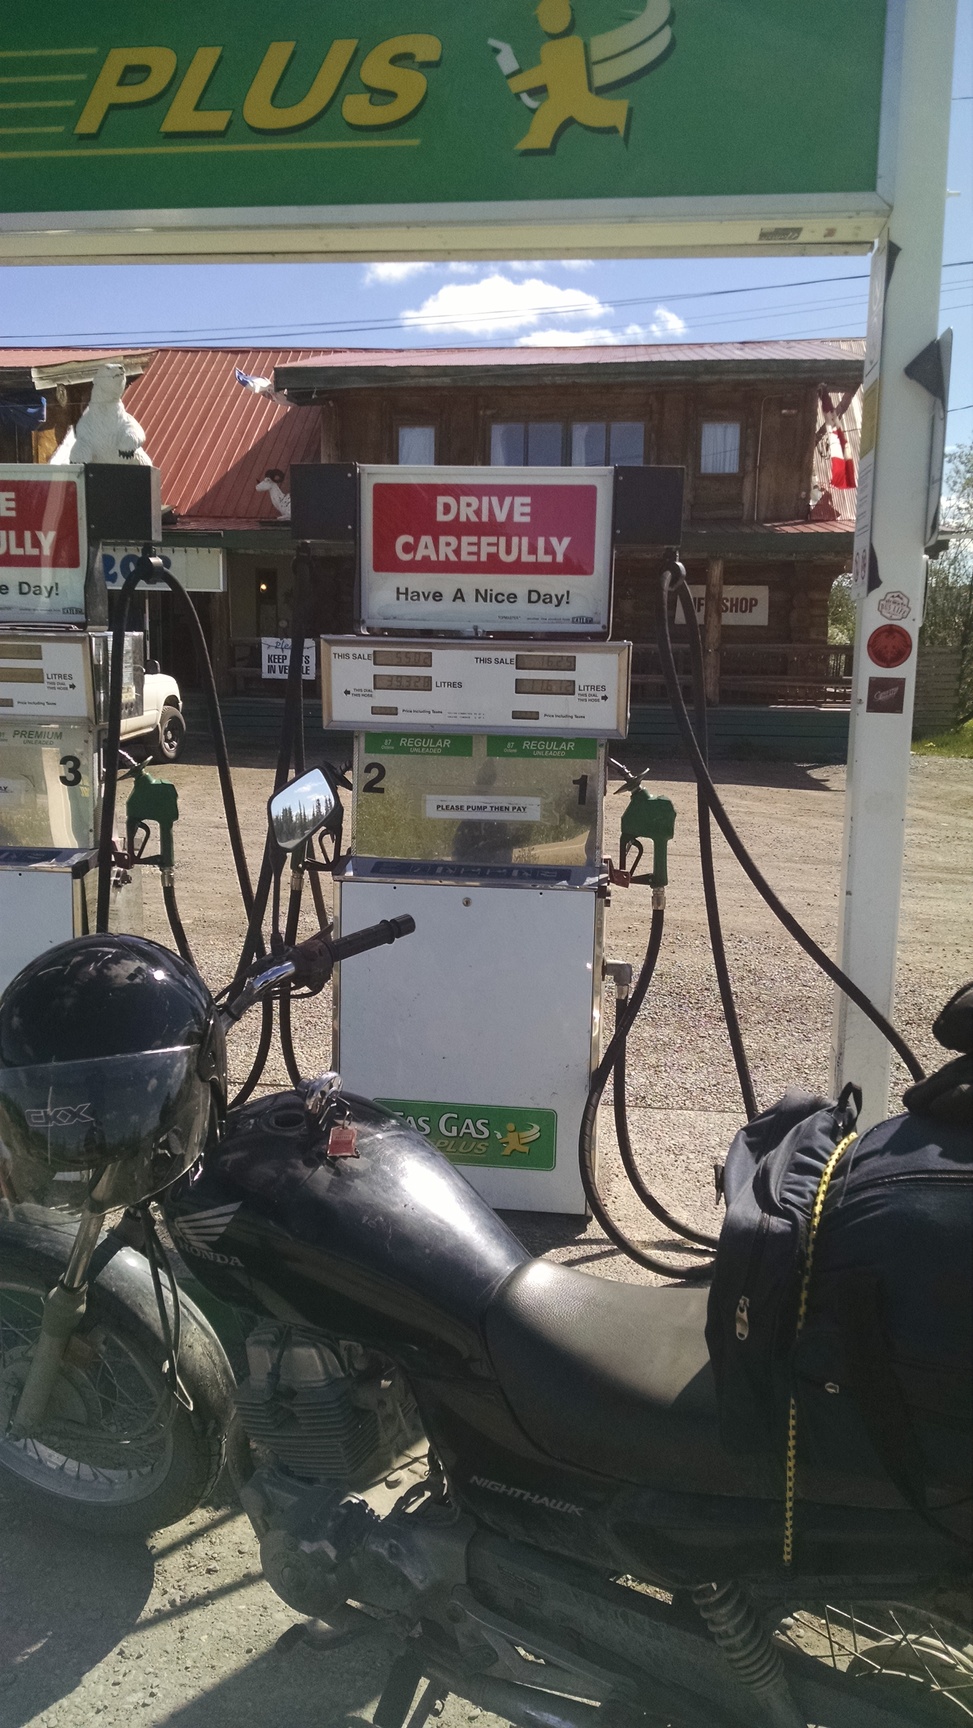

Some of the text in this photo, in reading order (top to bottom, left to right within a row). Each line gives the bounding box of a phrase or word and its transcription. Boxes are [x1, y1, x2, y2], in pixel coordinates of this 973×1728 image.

[74, 33, 443, 138] PLUS
[436, 495, 531, 522] DRIVE
[395, 534, 572, 563] CAREFULLY
[18, 581, 59, 599] Day!
[396, 587, 570, 608] Have A Nice Day!
[721, 597, 759, 613] SHOP
[267, 653, 288, 664] KEEP
[333, 652, 372, 661] THIS SALE
[474, 656, 515, 665] THIS SALE
[46, 673, 73, 681] LITRES
[267, 664, 277, 674] IN
[435, 681, 463, 689] LITRES
[578, 684, 607, 692] LITRES
[12, 730, 63, 740] PREMIUM
[399, 737, 451, 748] REGULAR
[522, 740, 575, 751] REGULAR
[60, 755, 82, 787] 3
[362, 762, 386, 794] 2
[572, 774, 588, 806] 1
[436, 804, 528, 813] PLEASE PUMP THEN PAY
[438, 1112, 491, 1139] GAS
[435, 1139, 490, 1156] PLUS
[178, 1238, 245, 1268] HONDA
[470, 1475, 584, 1517] NIGHTHAWK
